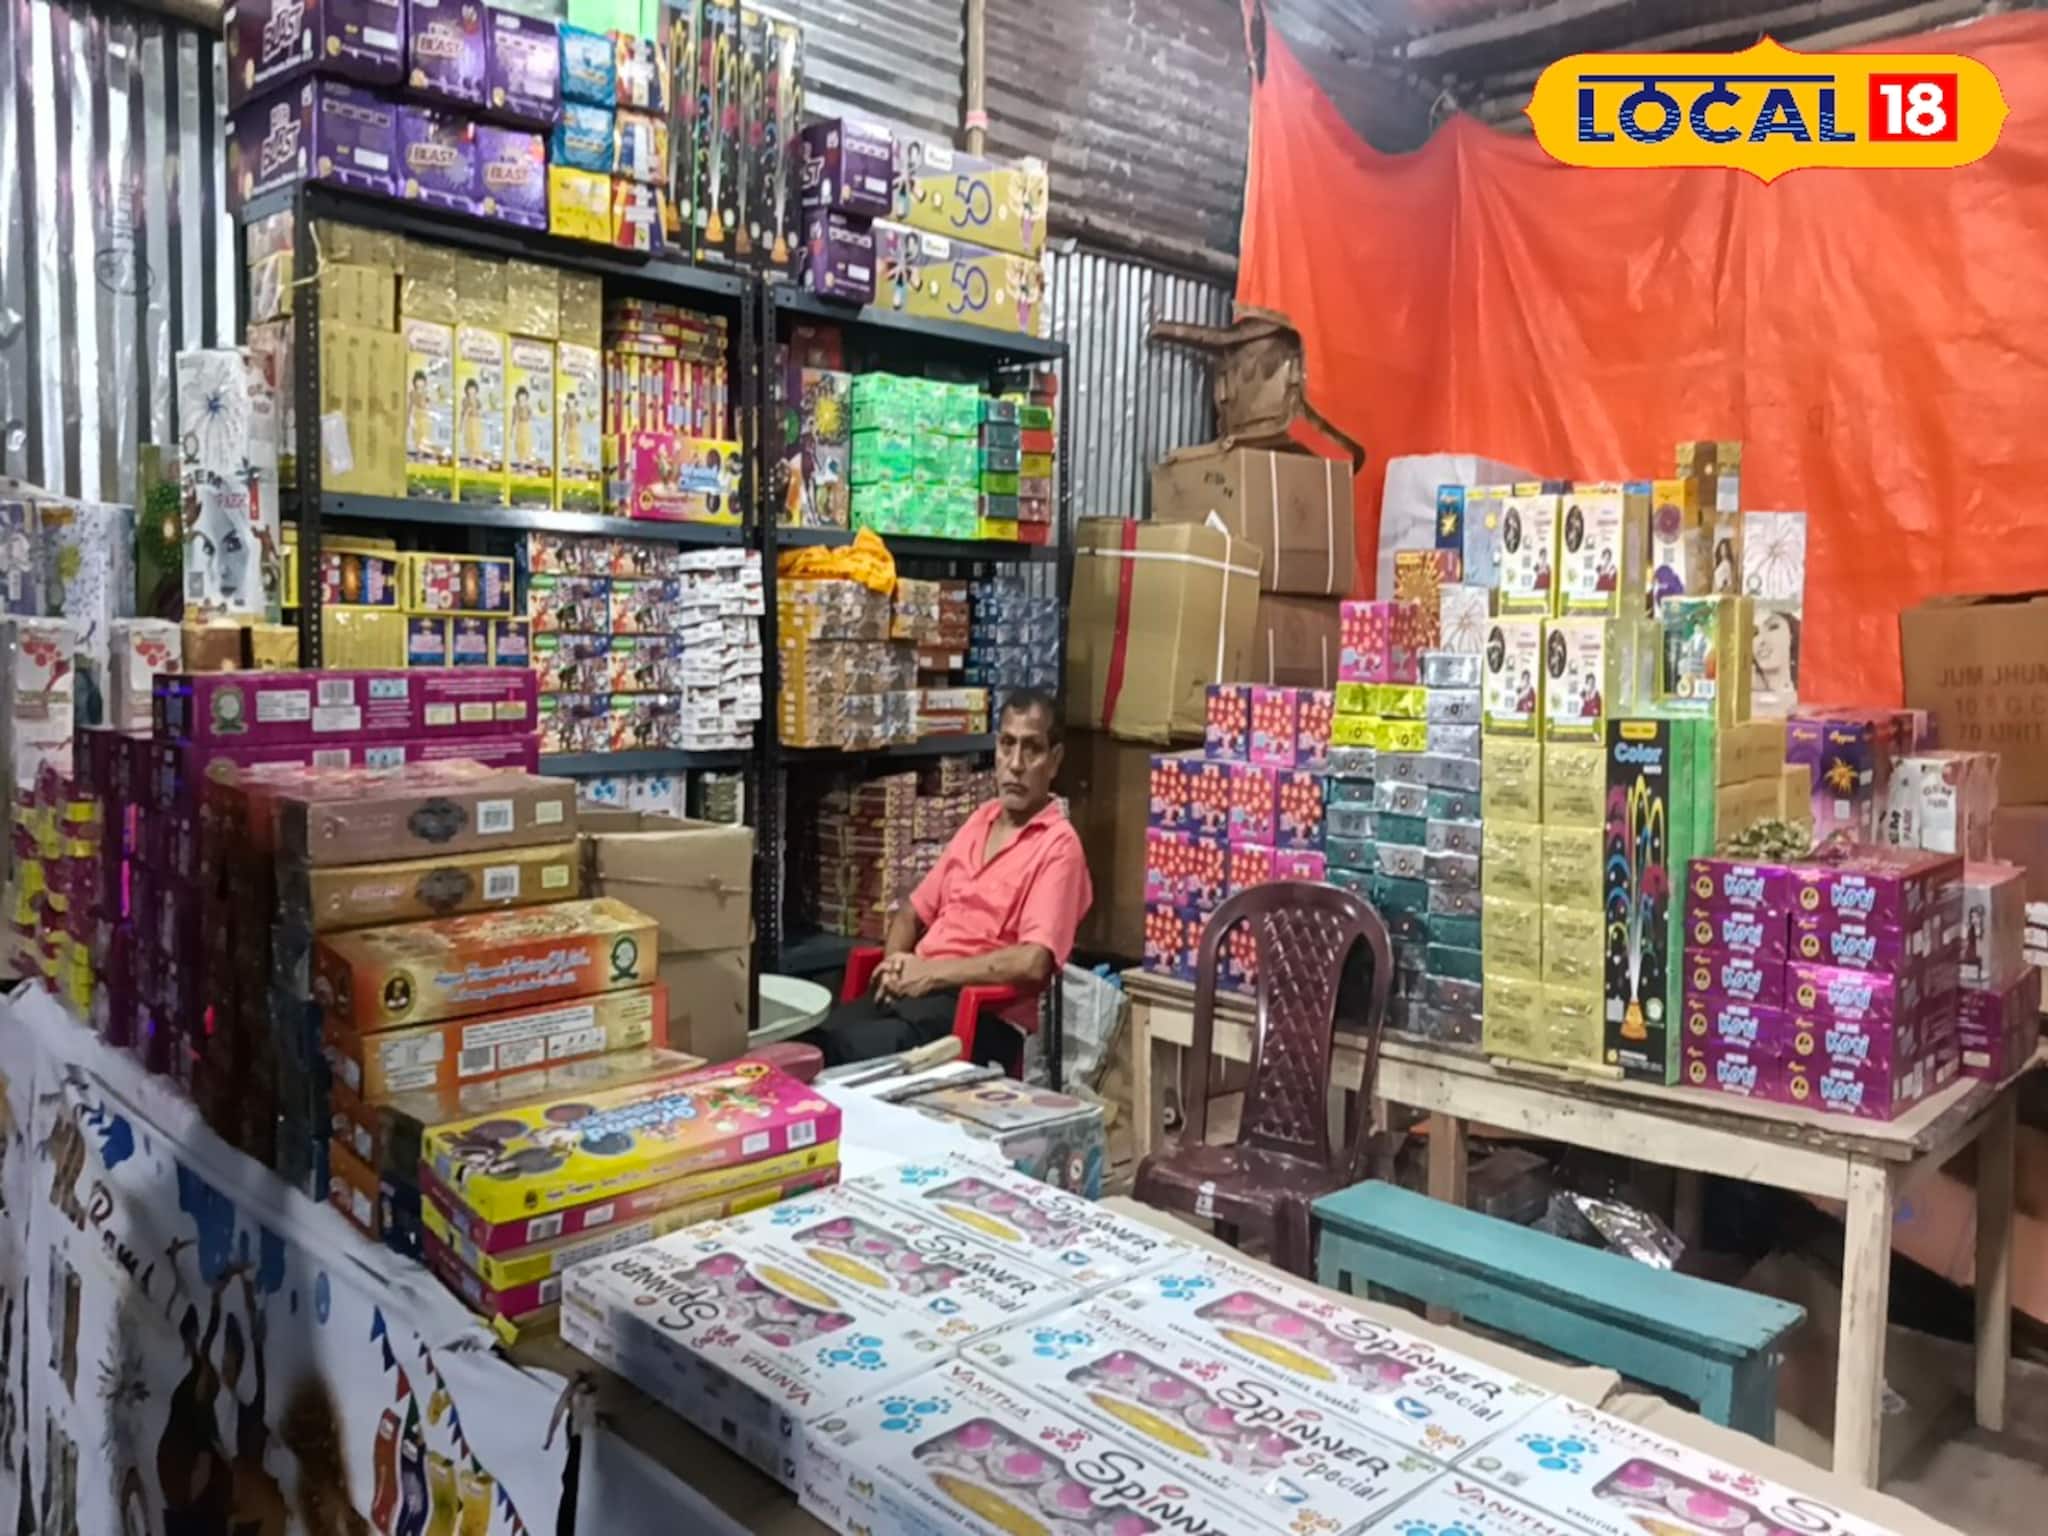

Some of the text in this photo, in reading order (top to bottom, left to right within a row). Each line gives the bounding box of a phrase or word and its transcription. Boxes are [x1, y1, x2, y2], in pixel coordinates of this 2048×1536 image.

[950, 175, 992, 227] 50
[947, 261, 989, 315] 50
[951, 1365, 1033, 1419] VANITHA
[1412, 1372, 1505, 1423] Special
[1564, 1402, 1681, 1459] VANITHA
[1299, 1452, 1389, 1502] Special
[1454, 1480, 1571, 1536] VANITH
